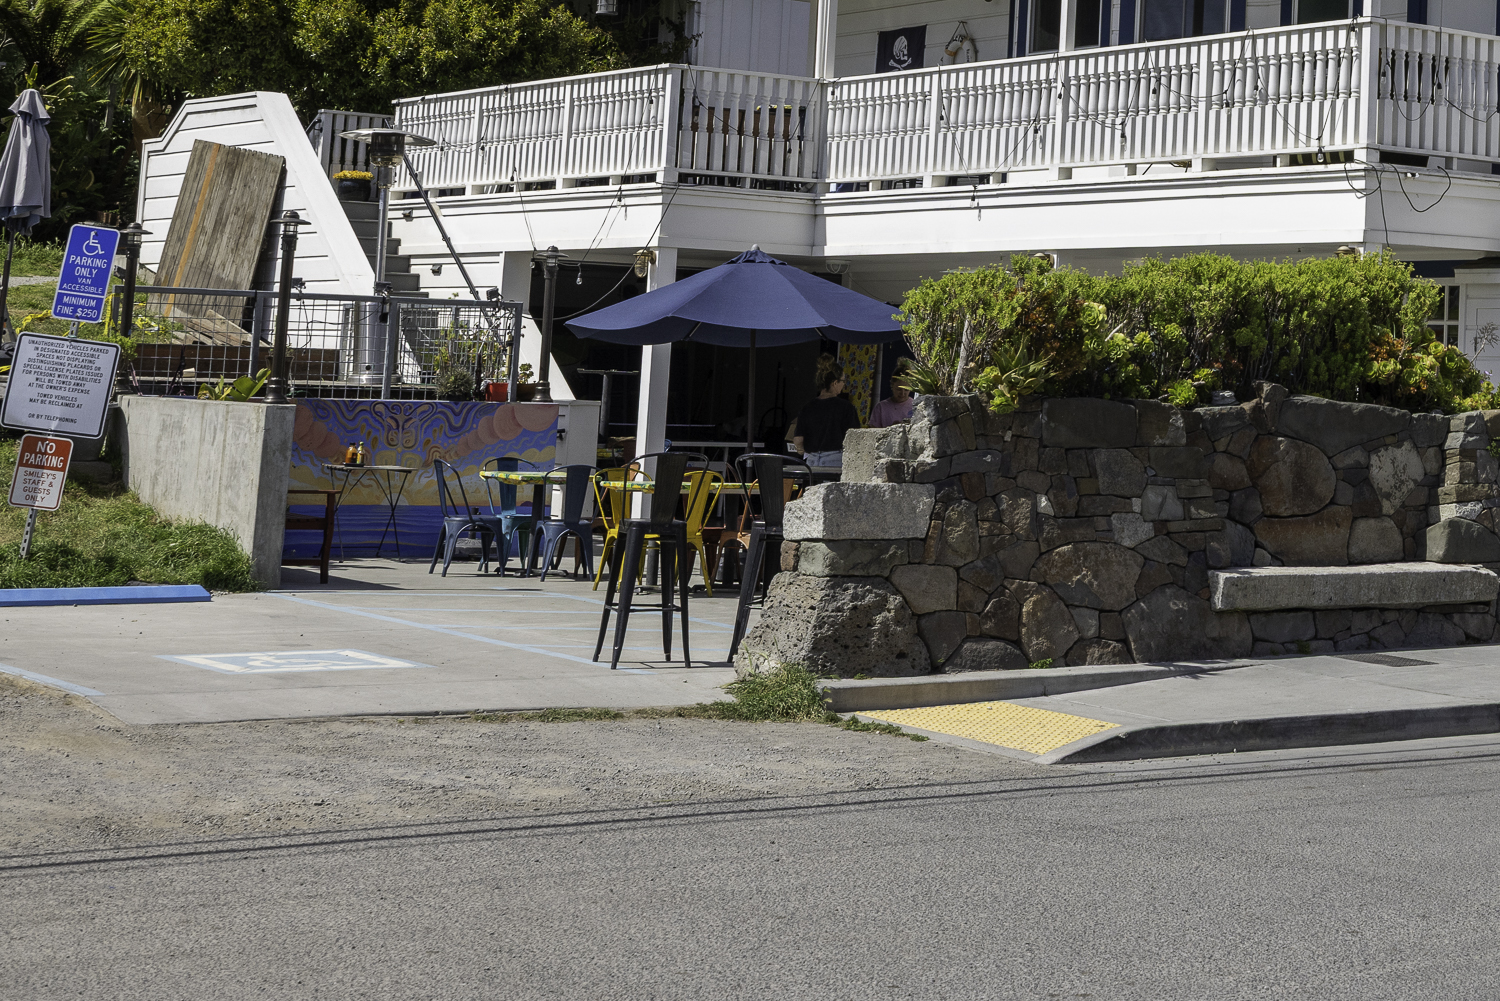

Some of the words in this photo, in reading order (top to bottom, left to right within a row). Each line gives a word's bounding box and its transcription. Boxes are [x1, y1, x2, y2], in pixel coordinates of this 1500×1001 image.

[69, 255, 107, 268] PARKING
[75, 267, 97, 277] ONLY
[62, 284, 102, 293] ACCESSIBLE
[63, 296, 96, 307] MINIMUM
[57, 306, 74, 315] FINE
[76, 308, 97, 318] $250
[28, 340, 65, 349] UNAUTHORIZED
[40, 348, 69, 356] DESIGNATED
[28, 358, 66, 367] DISTINGUISHING
[67, 356, 95, 364] DISPLAYING
[44, 415, 77, 423] TELEPHONING
[36, 441, 56, 453] NO
[23, 453, 64, 468] PARKING
[24, 470, 56, 479] SMILEY'S
[23, 487, 50, 495] GUESTS
